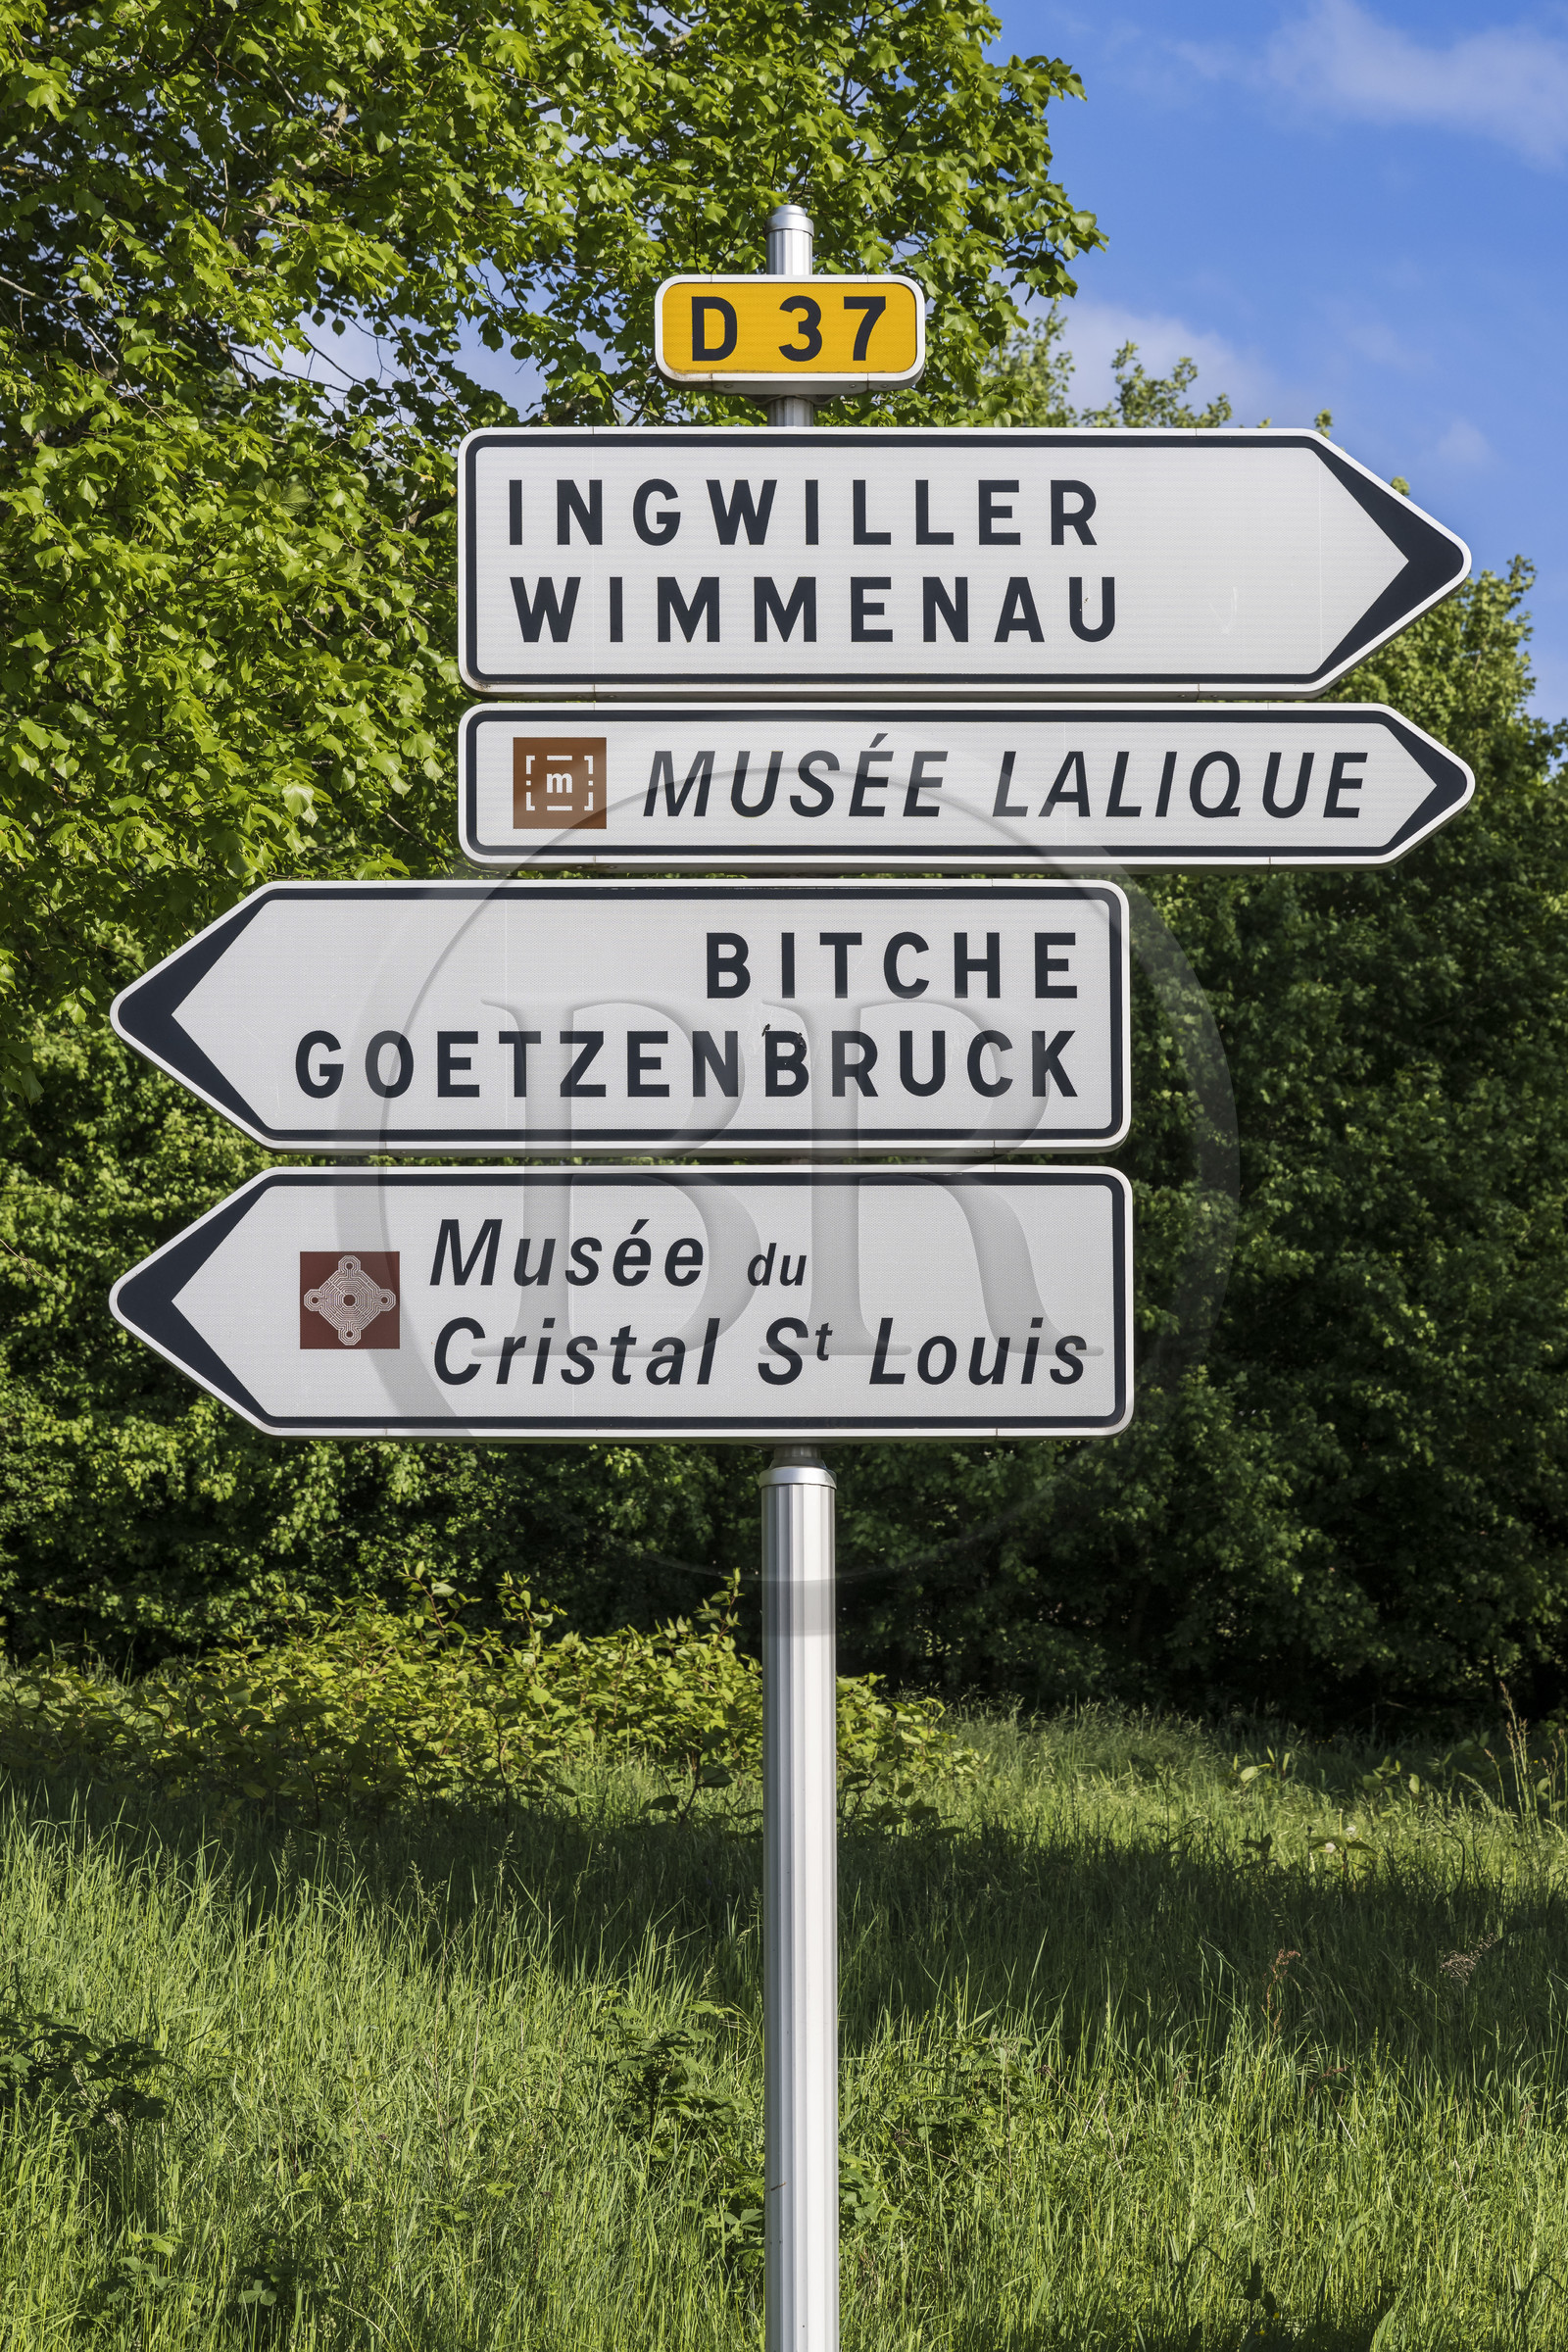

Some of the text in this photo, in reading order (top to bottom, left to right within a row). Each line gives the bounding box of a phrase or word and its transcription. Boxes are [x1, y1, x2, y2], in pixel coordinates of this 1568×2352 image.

[692, 295, 886, 362] D 37
[510, 479, 1097, 546] INGWILLER
[510, 577, 1115, 642] WIMMENAU
[644, 734, 1367, 818] MUSÉE LALIQUE
[707, 932, 1077, 999] BITCHE
[296, 1029, 1077, 1099] GOETZENBRUCK
[430, 1219, 807, 1287] Musée du
[434, 1317, 1087, 1385] Cristal St Louis
